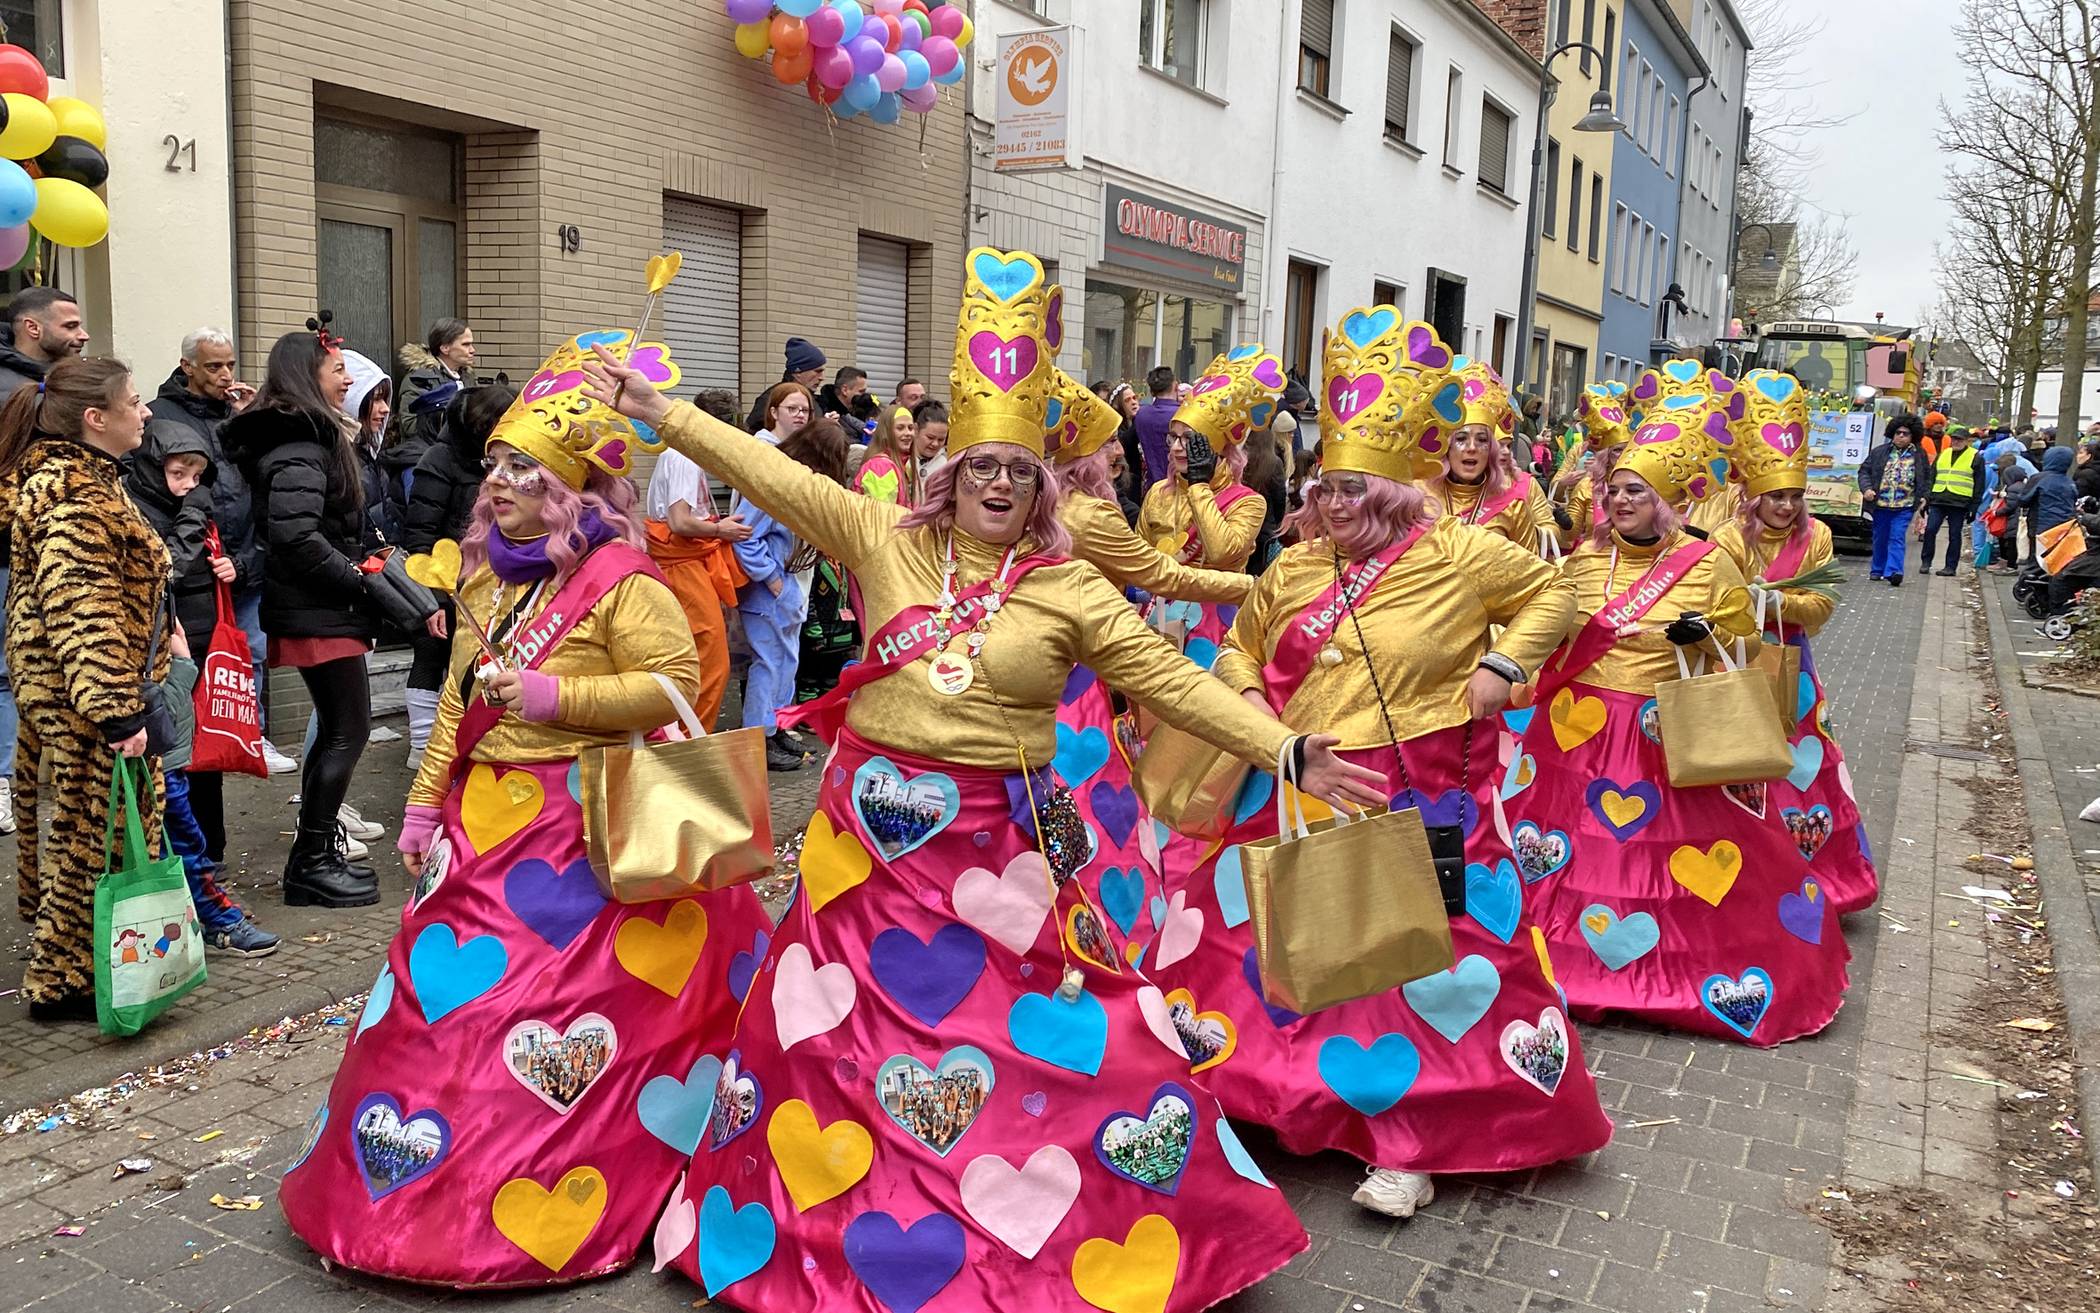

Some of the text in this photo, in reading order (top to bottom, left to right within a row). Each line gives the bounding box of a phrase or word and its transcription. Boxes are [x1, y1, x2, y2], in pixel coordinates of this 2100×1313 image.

[163, 134, 196, 173] 21
[996, 142, 1027, 154] 29445
[1035, 139, 1065, 152] 21083
[558, 224, 580, 253] 19
[1117, 198, 1244, 264] OLYMPIA SERVICE
[988, 346, 1017, 376] 11
[530, 378, 558, 396] 11
[1196, 381, 1214, 393] 11
[1337, 389, 1360, 414] 11
[1608, 410, 1622, 420] 11
[1642, 428, 1661, 440] 11
[1849, 424, 1862, 433] 52
[1777, 432, 1796, 449] 11
[1846, 448, 1859, 458] 53
[1300, 557, 1388, 639] Herzblut
[211, 698, 235, 719] DEIN
